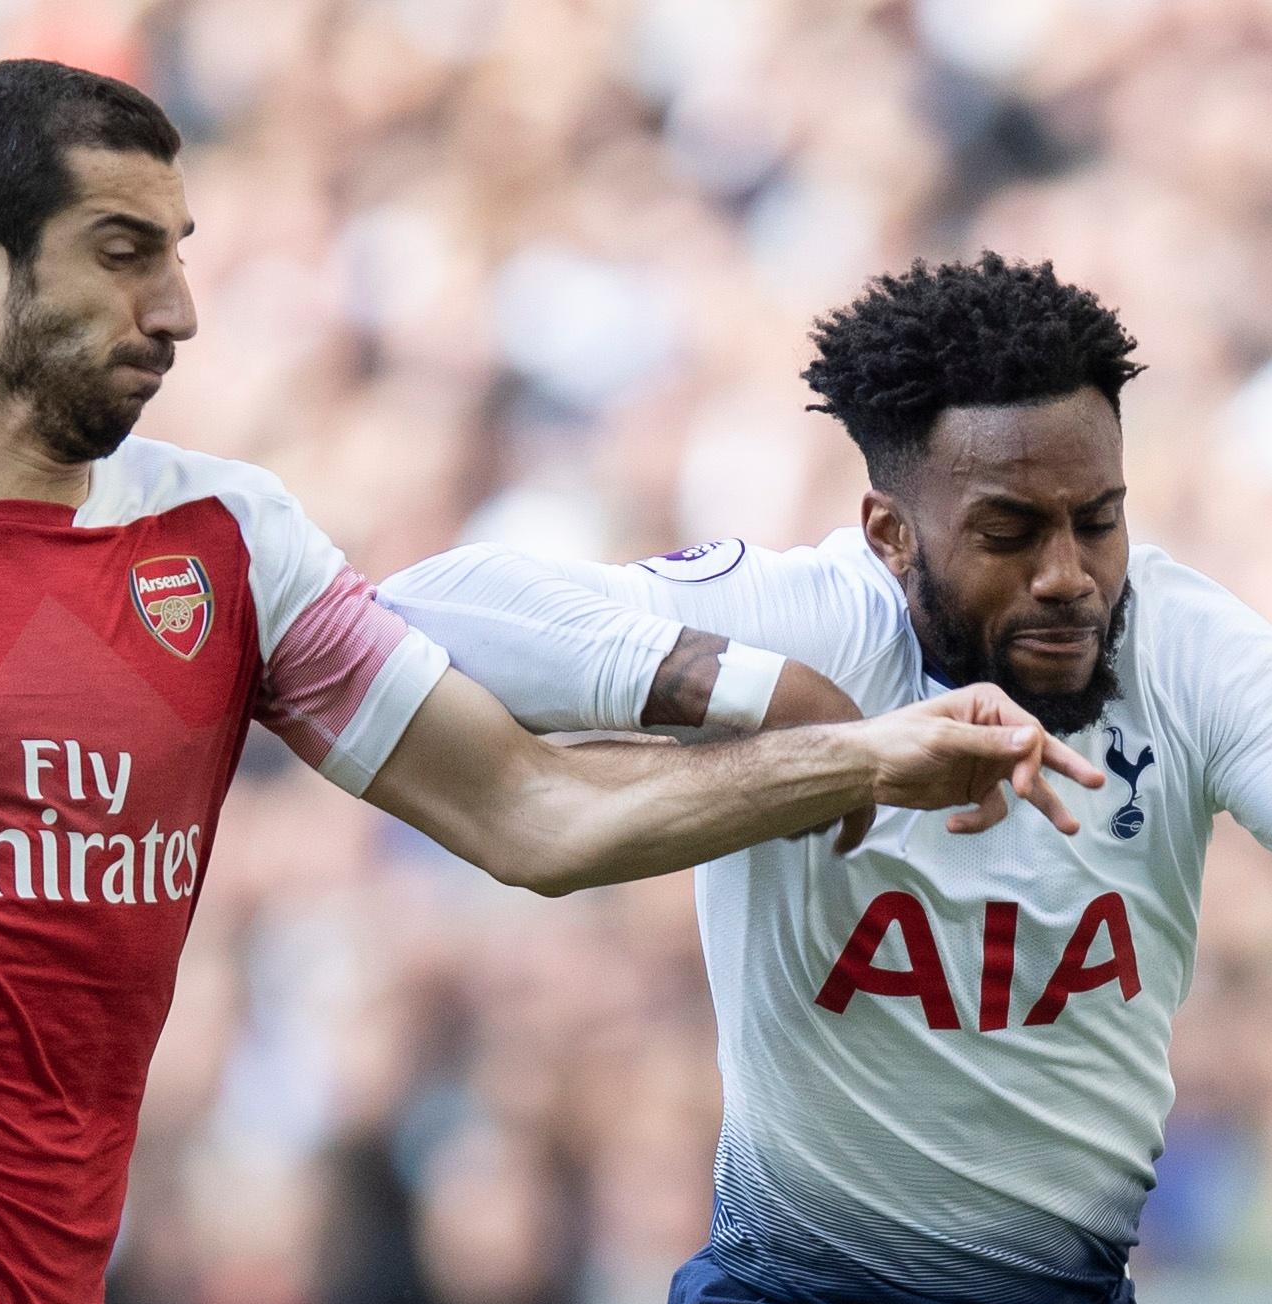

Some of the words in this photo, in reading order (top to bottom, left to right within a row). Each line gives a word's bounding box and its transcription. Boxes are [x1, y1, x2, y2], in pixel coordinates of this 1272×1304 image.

[138, 567, 197, 594] Arsenal
[21, 739, 132, 815] Fly
[814, 890, 1143, 1033] AIA
